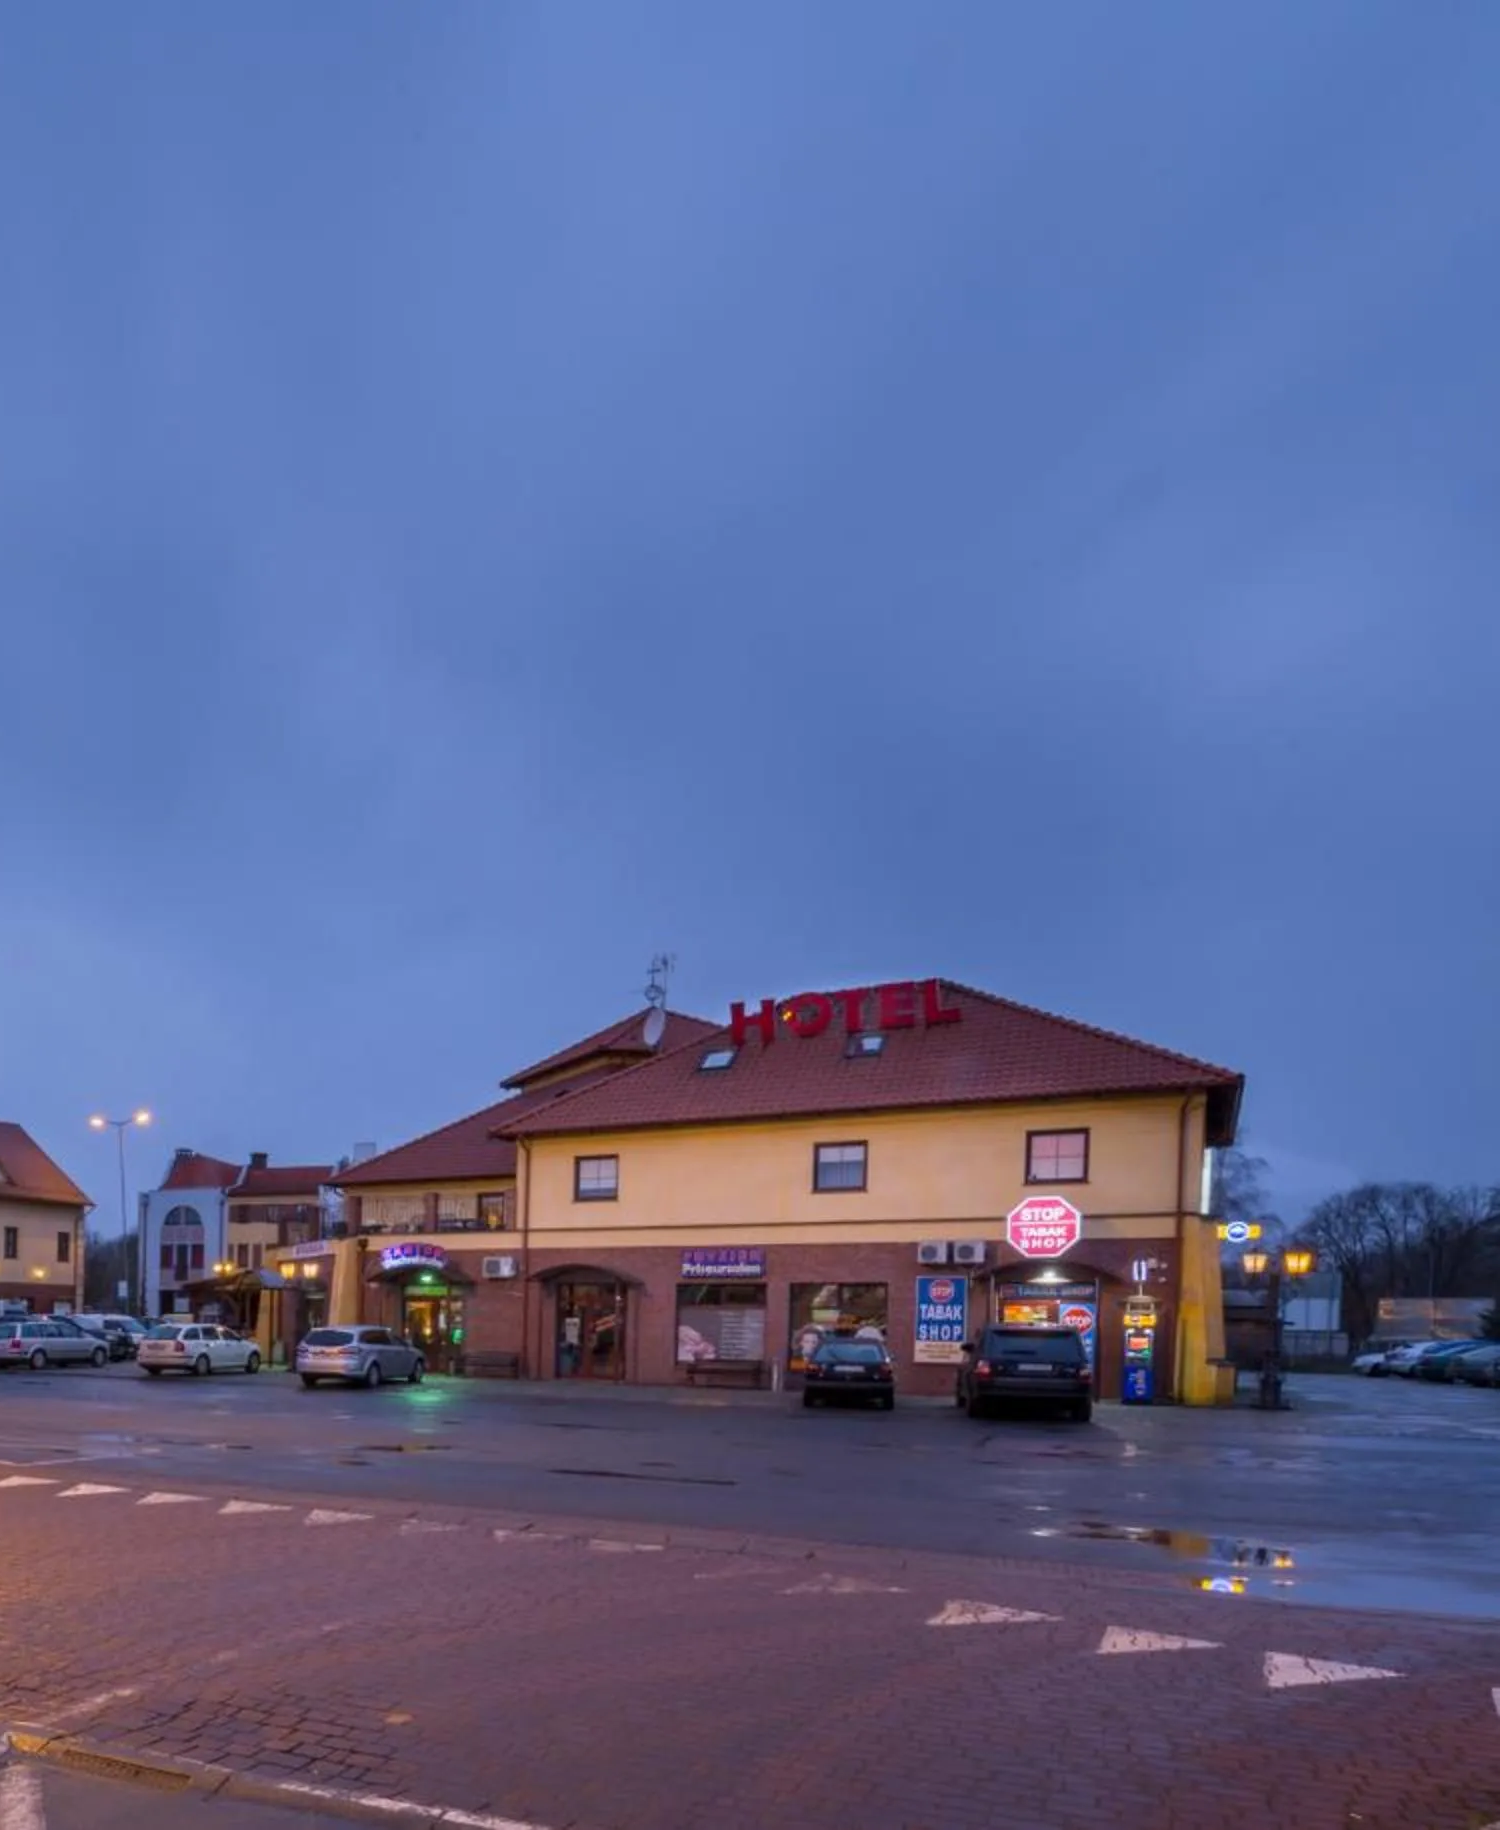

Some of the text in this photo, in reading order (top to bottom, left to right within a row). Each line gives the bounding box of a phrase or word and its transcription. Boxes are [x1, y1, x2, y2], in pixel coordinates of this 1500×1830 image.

[730, 978, 962, 1048] HOTEL
[1021, 1207, 1066, 1221] STOP
[1021, 1227, 1068, 1238] TABAK
[1020, 1238, 1067, 1249] SHOP
[920, 1304, 963, 1320] TABAK
[919, 1325, 961, 1341] SHOP
